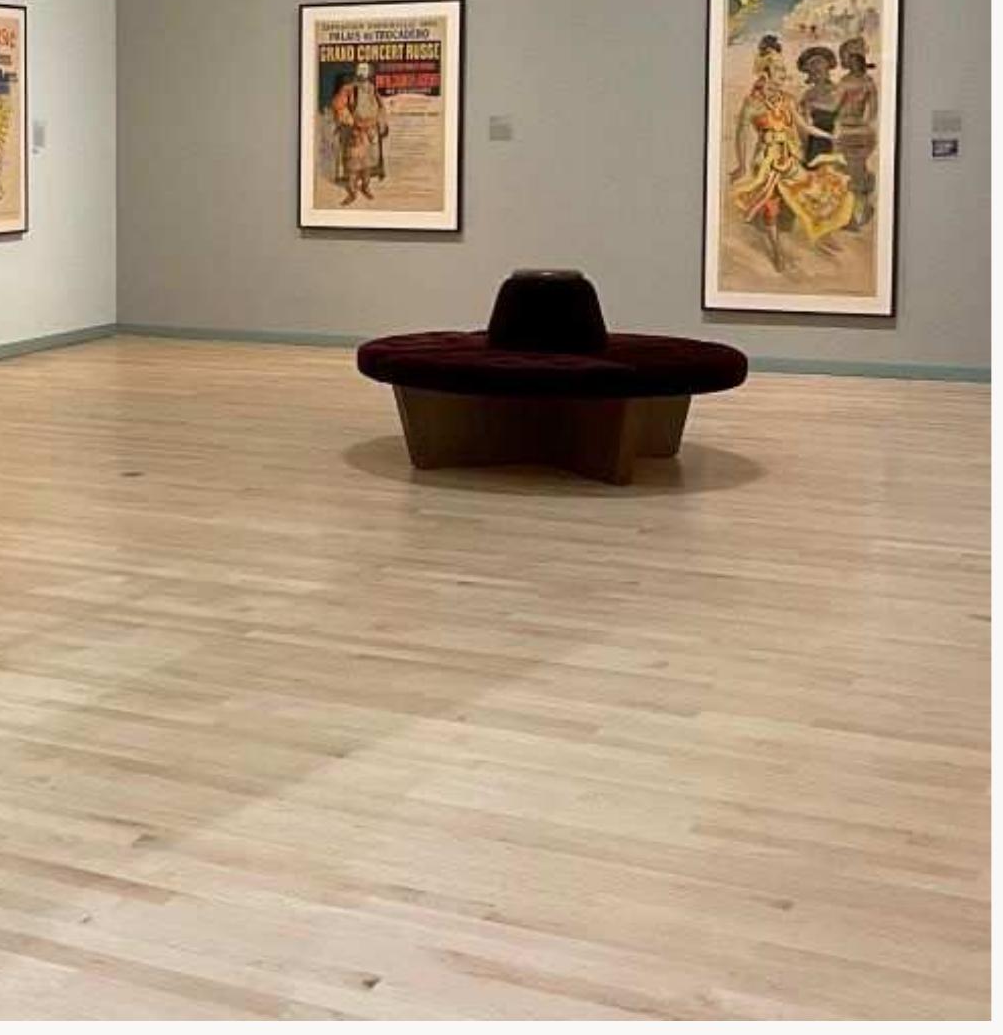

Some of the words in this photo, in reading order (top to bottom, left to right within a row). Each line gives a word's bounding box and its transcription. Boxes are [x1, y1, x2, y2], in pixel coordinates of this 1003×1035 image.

[320, 44, 354, 62] GRAND
[357, 43, 404, 61] CONCERT
[406, 42, 440, 60] RUSSE
